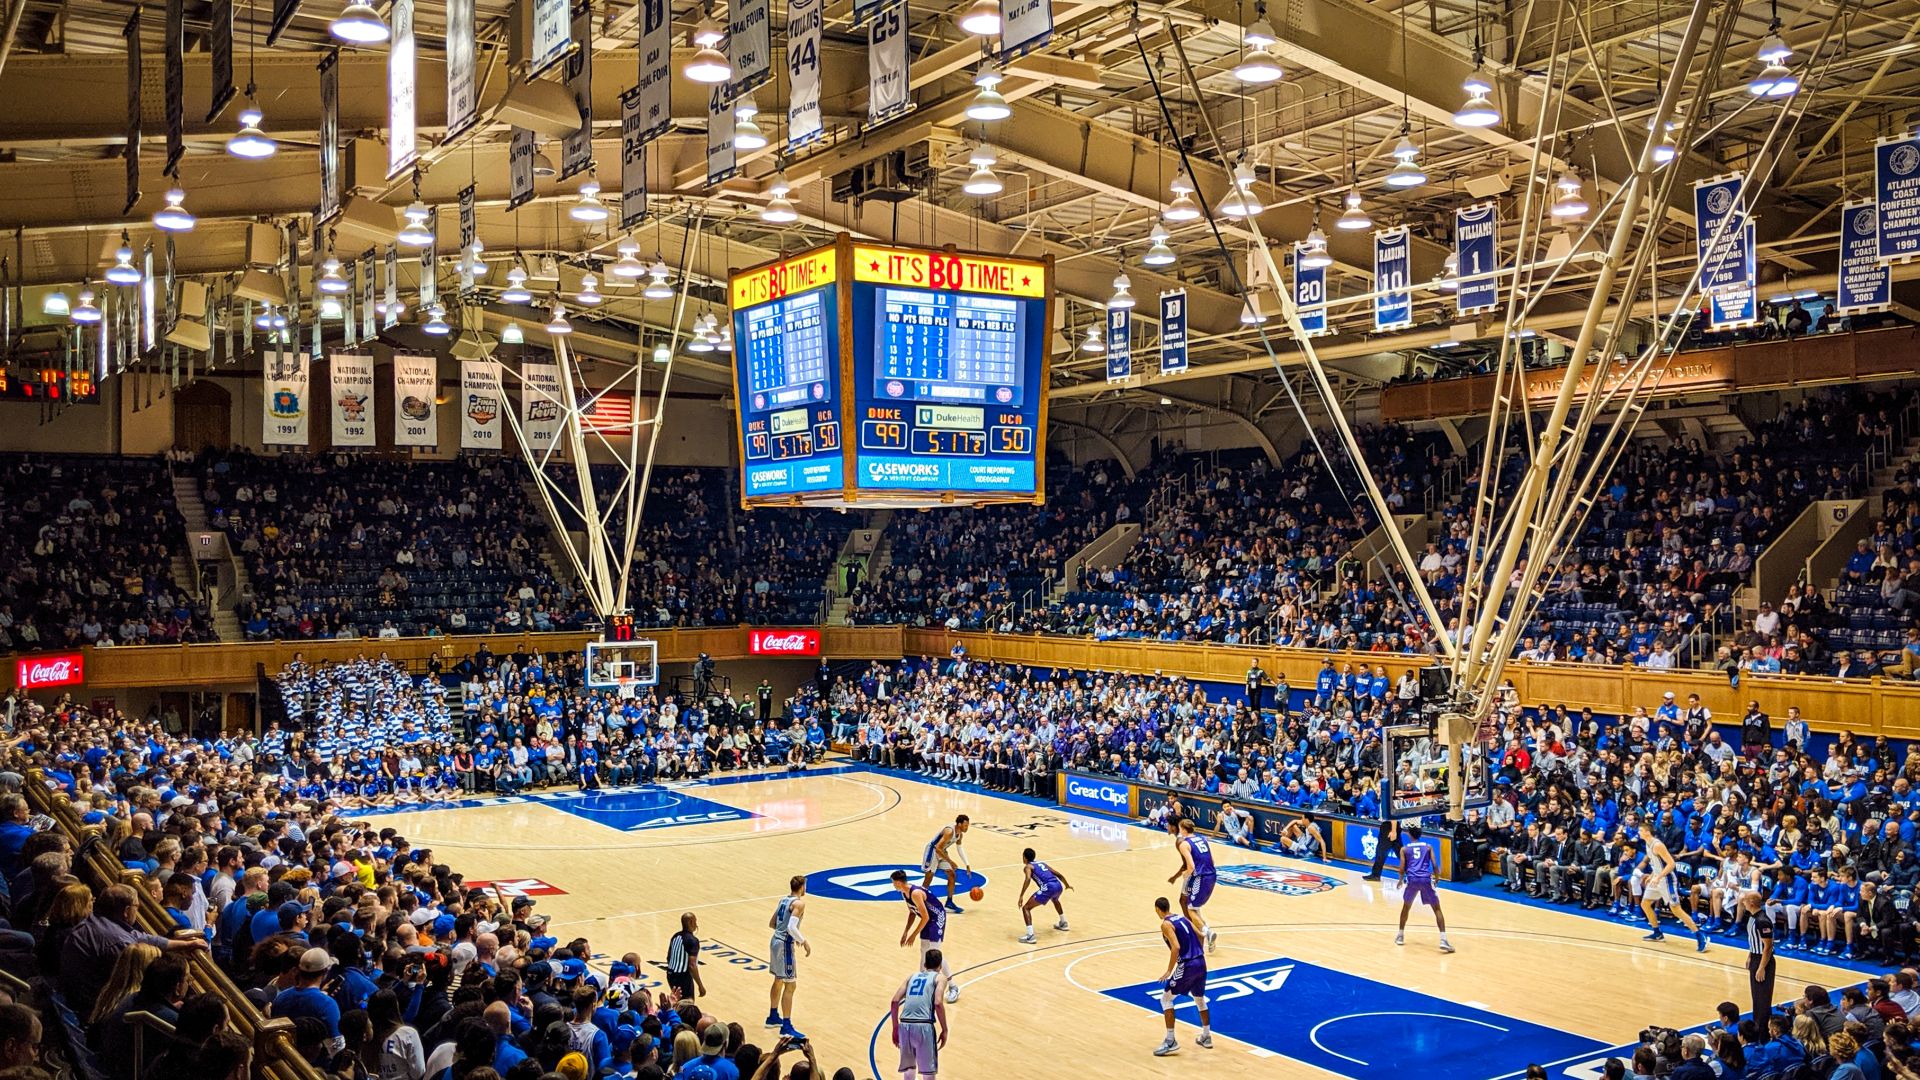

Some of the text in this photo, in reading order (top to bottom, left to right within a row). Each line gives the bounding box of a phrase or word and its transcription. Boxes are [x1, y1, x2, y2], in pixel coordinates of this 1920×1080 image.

[746, 7, 764, 27] FOUR
[873, 4, 899, 44] 25
[791, 38, 816, 76] 44
[1887, 178, 1920, 190] ATLANTI
[1893, 188, 1918, 199] COAST
[1881, 200, 1920, 211] CONFEREN
[1887, 207, 1920, 219] WOMEN'
[1711, 225, 1731, 236] COST
[1883, 219, 1920, 230] CHAMPIO
[1459, 222, 1492, 240] WILLIAMS
[1850, 238, 1877, 249] ATLANTI
[1896, 240, 1917, 250] 1999
[1379, 245, 1405, 263] HARDING
[1854, 247, 1876, 256] COAST
[1472, 251, 1481, 274] 1
[888, 253, 1014, 291] IT'S BO TIME!
[1715, 272, 1732, 282] 1998
[1844, 272, 1885, 284] CHAMPIONS
[749, 275, 766, 302] IT'S
[769, 263, 787, 300] BO
[789, 259, 817, 290] TIME!
[1381, 271, 1403, 297] 10
[1300, 280, 1320, 303] 20
[1716, 291, 1751, 301] CHAMPIONS
[1854, 293, 1874, 302] 2003
[889, 314, 947, 326] NO PTS REB FLS
[1725, 310, 1741, 319] 2002
[959, 319, 1014, 332] NO PTS REB FLS
[337, 366, 368, 374] NATIONAL
[401, 367, 431, 376] NATIONAL
[334, 376, 372, 385] CHAMPIONS
[397, 377, 434, 386] CHAMPIONS
[528, 374, 556, 382] NATIONAL
[464, 381, 496, 390] CHAMPION
[1530, 376, 1590, 393] CAMEN
[469, 403, 496, 414] FOUR
[531, 407, 557, 419] FOUR
[868, 407, 901, 420] DUKE
[936, 413, 981, 424] DukeHealth
[1000, 414, 1022, 425] UCA
[407, 427, 426, 435] 2001
[749, 421, 765, 431] DUKE
[821, 425, 834, 447] 50
[876, 424, 899, 445] 99
[1002, 429, 1024, 450] 50
[753, 435, 766, 454] 99
[780, 435, 802, 457] 5:17
[805, 441, 809, 453] 2
[928, 431, 968, 453] 5:17
[973, 440, 981, 452] 2
[752, 469, 787, 482] CASEWORKS
[868, 463, 939, 476] CASEWORKS
[987, 466, 1015, 474] REPORTING
[1069, 781, 1126, 806] Great Clips
[627, 810, 740, 829] ACC
[1194, 841, 1208, 853] 15
[1413, 848, 1420, 859] 5
[1038, 864, 1048, 872] 2
[1894, 900, 1910, 910] DUK
[776, 904, 786, 922] 4
[1179, 920, 1190, 934] 1
[908, 978, 928, 996] 21
